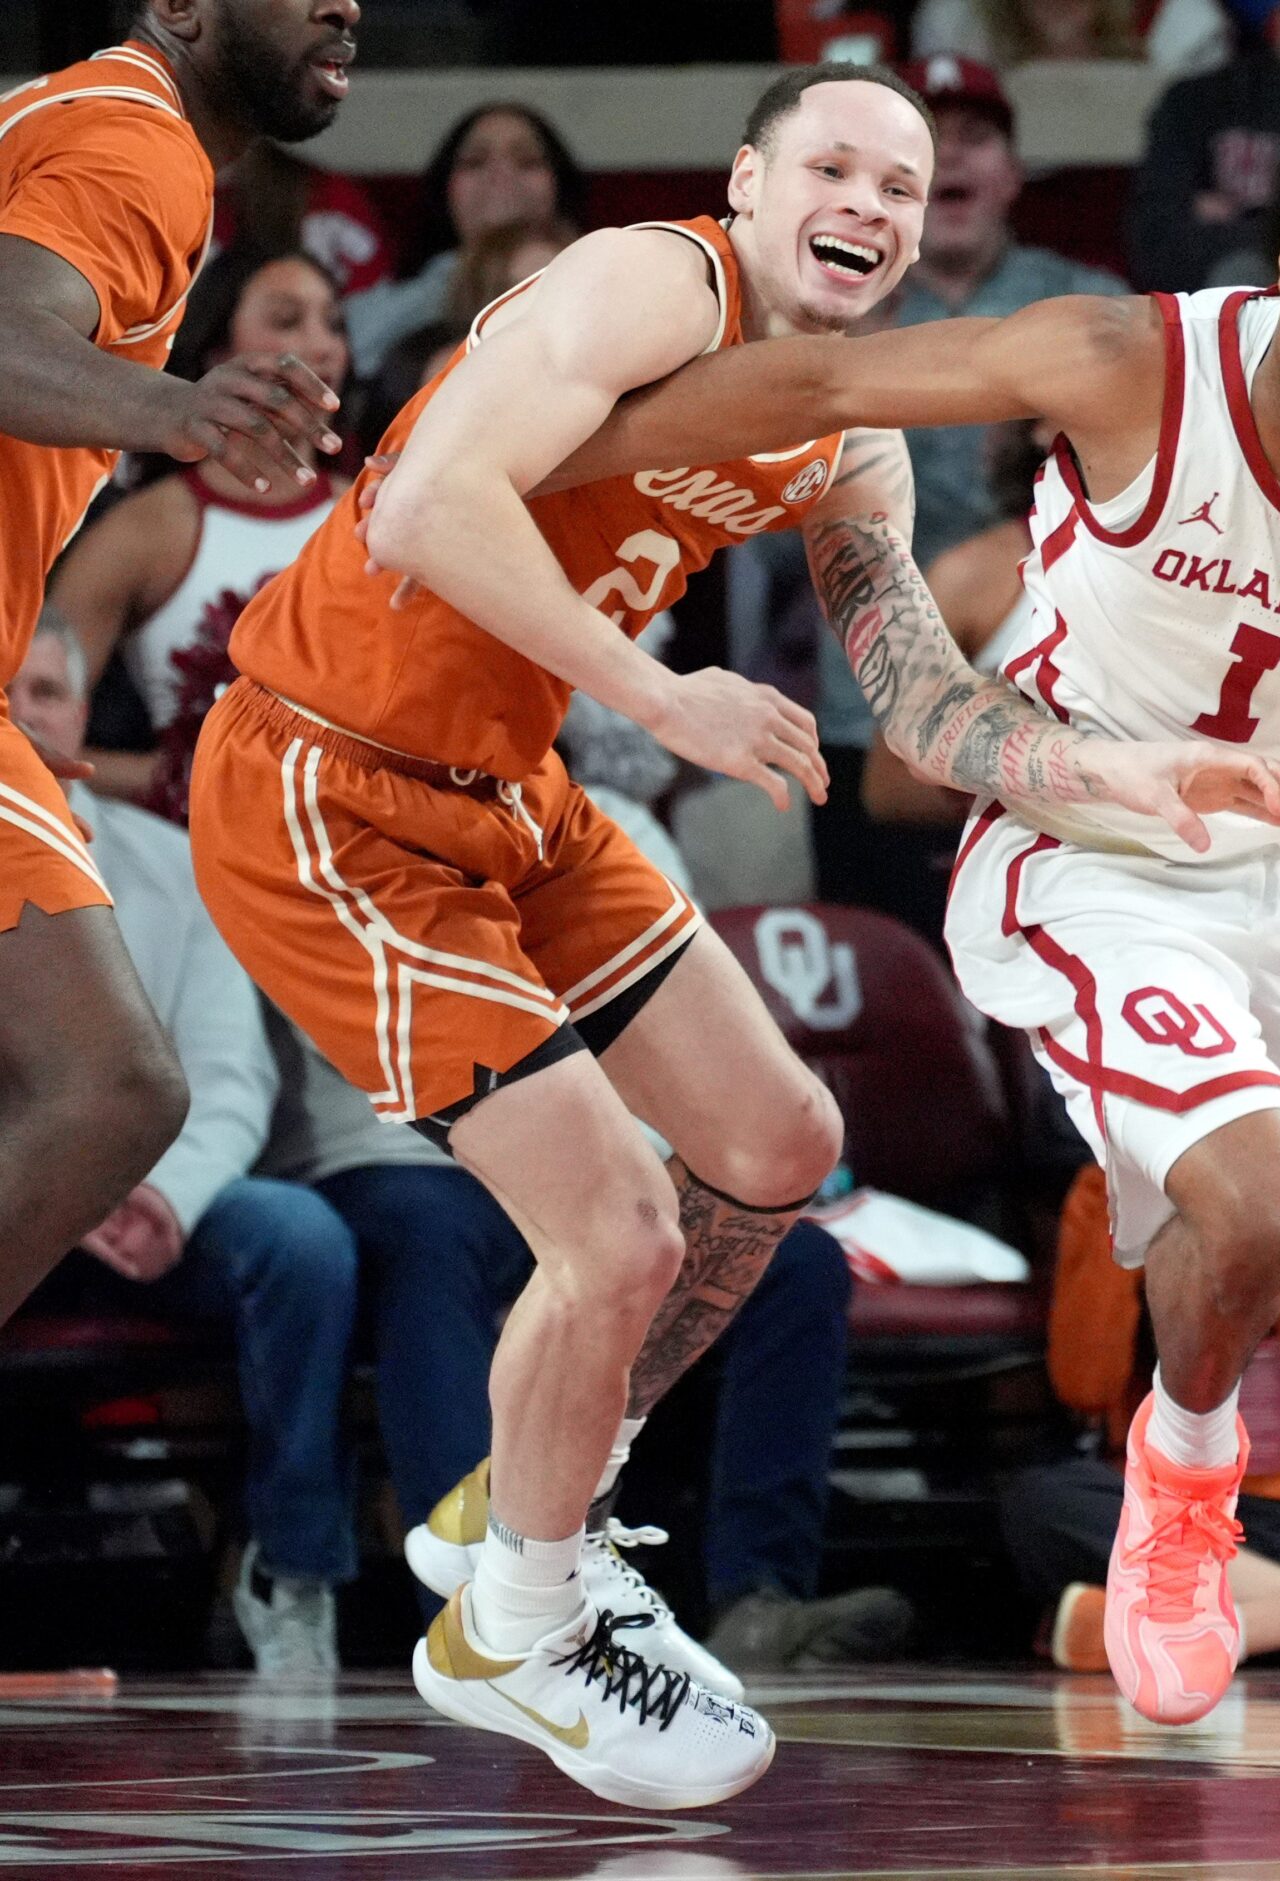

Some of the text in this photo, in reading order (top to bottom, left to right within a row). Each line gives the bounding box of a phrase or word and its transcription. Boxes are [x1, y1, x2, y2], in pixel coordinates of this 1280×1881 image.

[633, 466, 787, 534] exas
[581, 528, 680, 627] 2
[754, 908, 863, 1031] OU
[1121, 986, 1236, 1059] OU
